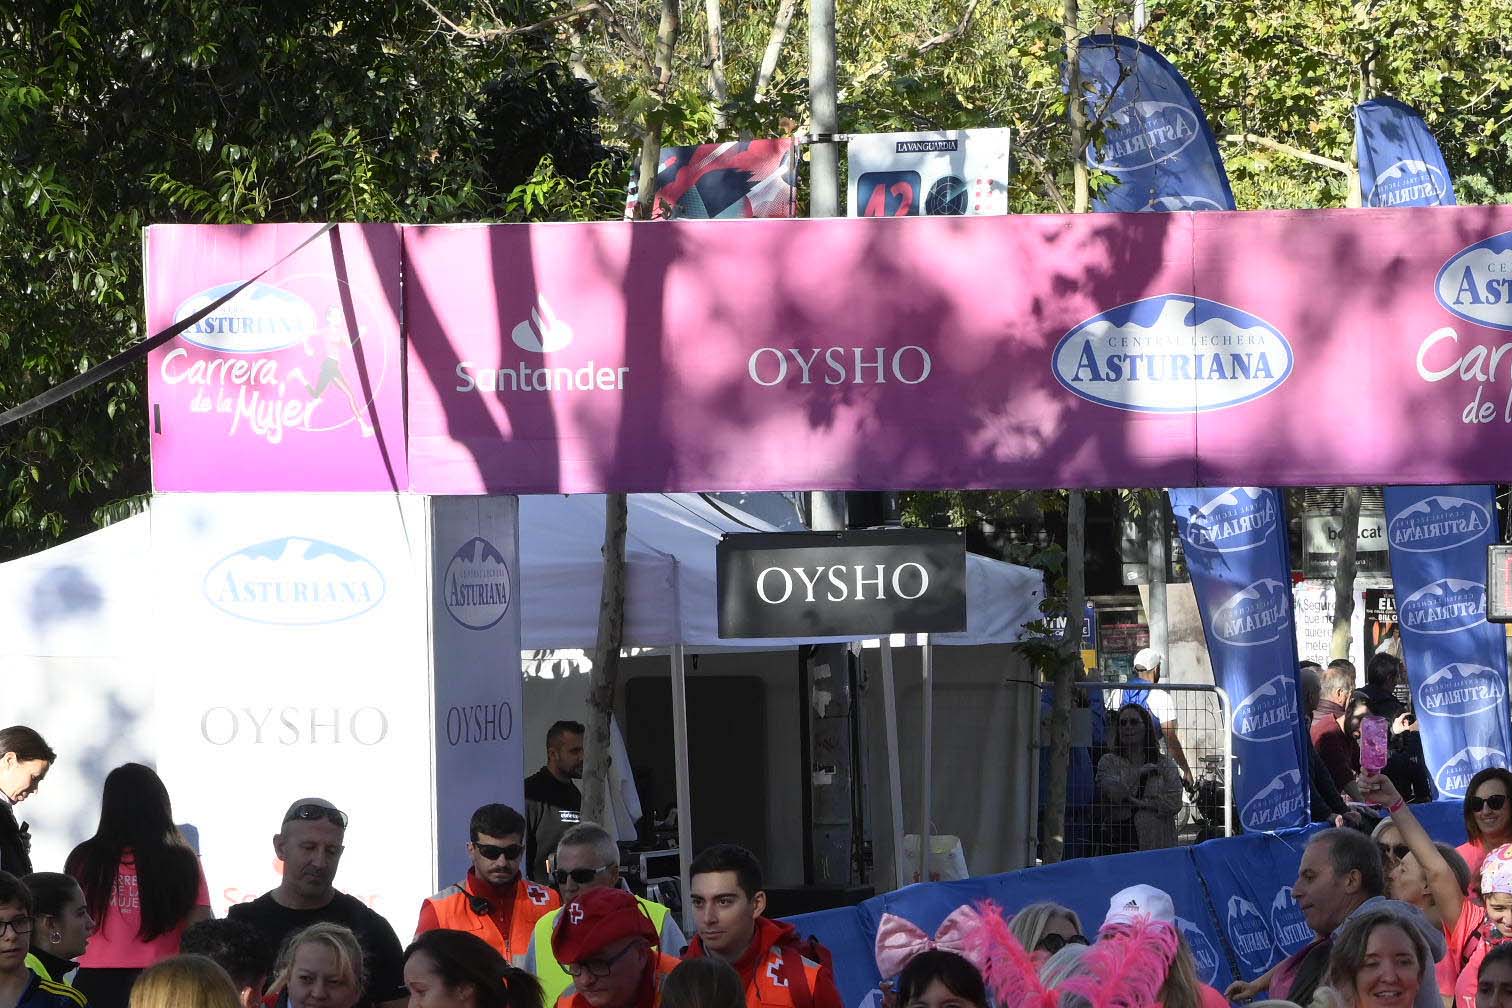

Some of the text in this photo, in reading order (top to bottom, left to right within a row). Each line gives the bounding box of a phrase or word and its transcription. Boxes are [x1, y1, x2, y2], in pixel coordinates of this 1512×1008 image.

[1191, 335, 1266, 346] LECHERA
[161, 348, 278, 384] Carrera
[456, 360, 630, 392] Santander
[747, 345, 933, 386] OYSHO
[1071, 338, 1275, 383] ASTURIANA
[190, 383, 322, 444] de la Mujer
[1462, 385, 1497, 424] de
[219, 569, 372, 603] ASTURIANA
[449, 574, 508, 607] ASTURIANA
[756, 562, 930, 605] OYSHO
[200, 706, 389, 745] OYSHO
[446, 702, 513, 746] OYSHO
